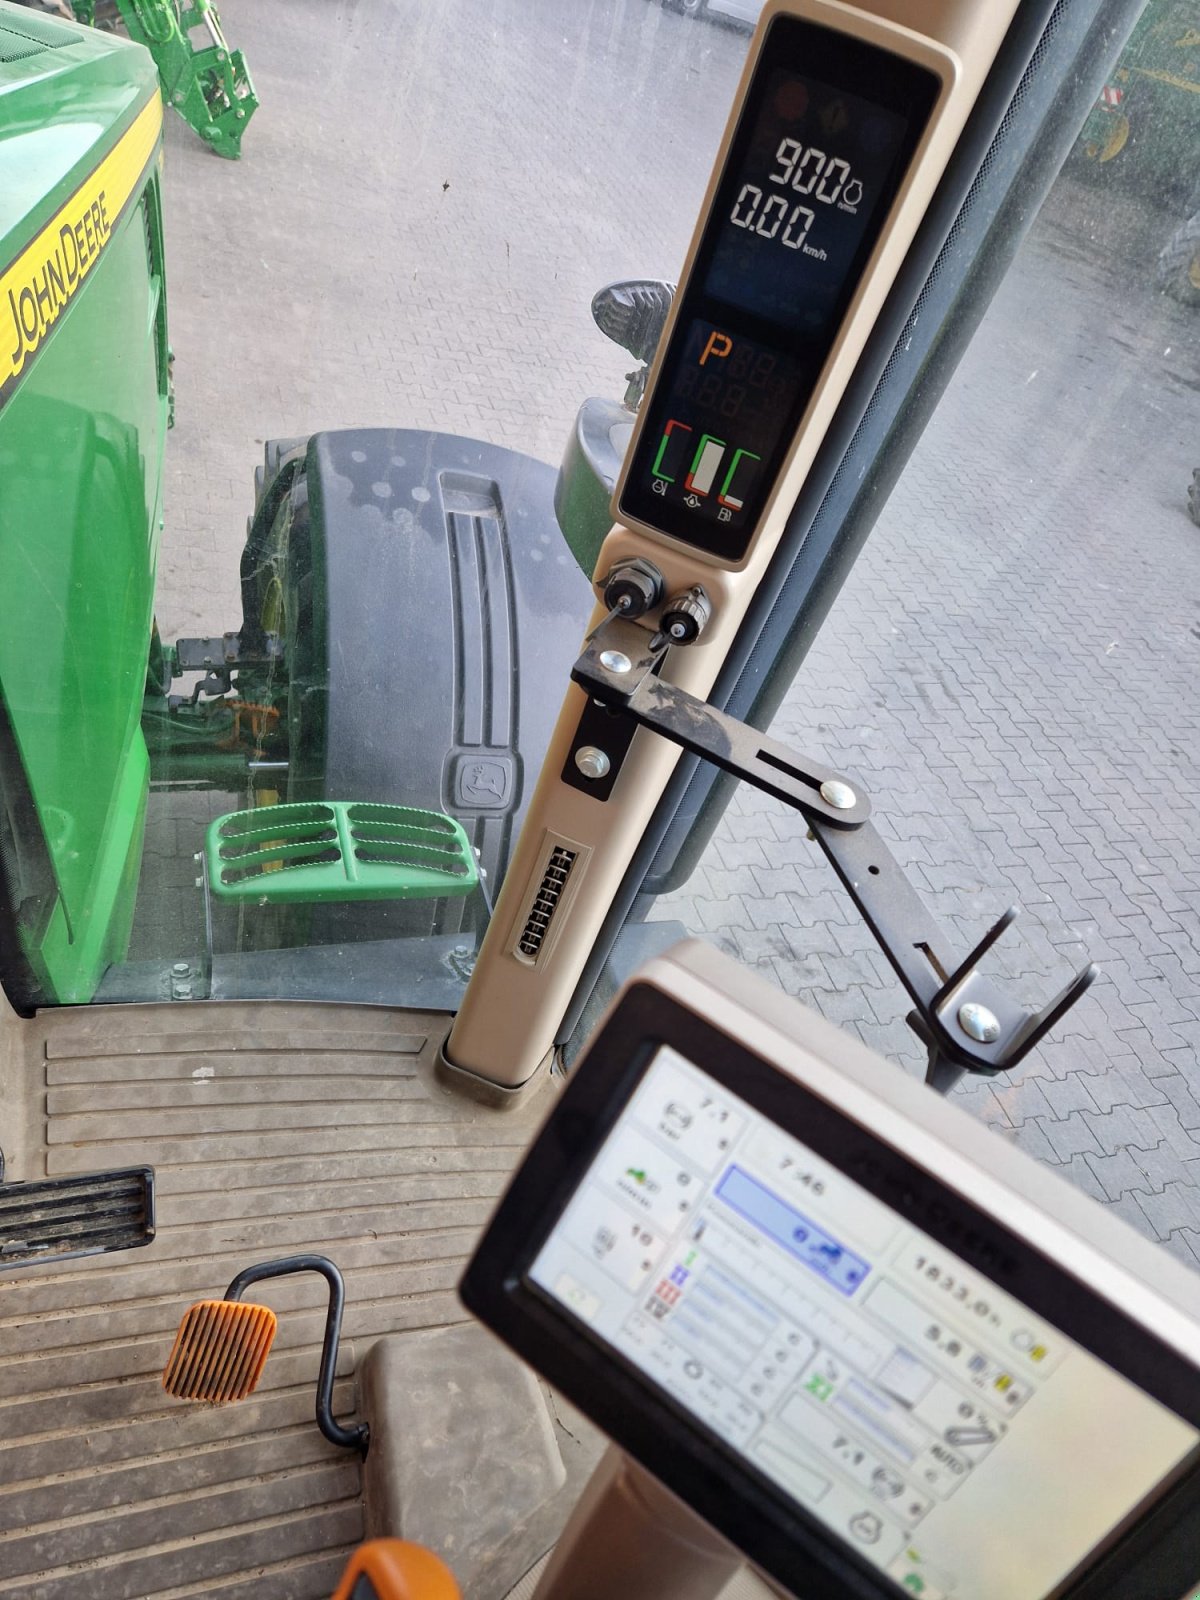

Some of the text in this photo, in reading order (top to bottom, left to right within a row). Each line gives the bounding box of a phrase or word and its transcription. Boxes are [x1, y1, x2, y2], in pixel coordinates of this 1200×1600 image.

[769, 138, 851, 204] 900
[730, 184, 828, 261] 0.00 km/h
[8, 190, 110, 366] JOHN DEERE
[699, 331, 733, 366] P
